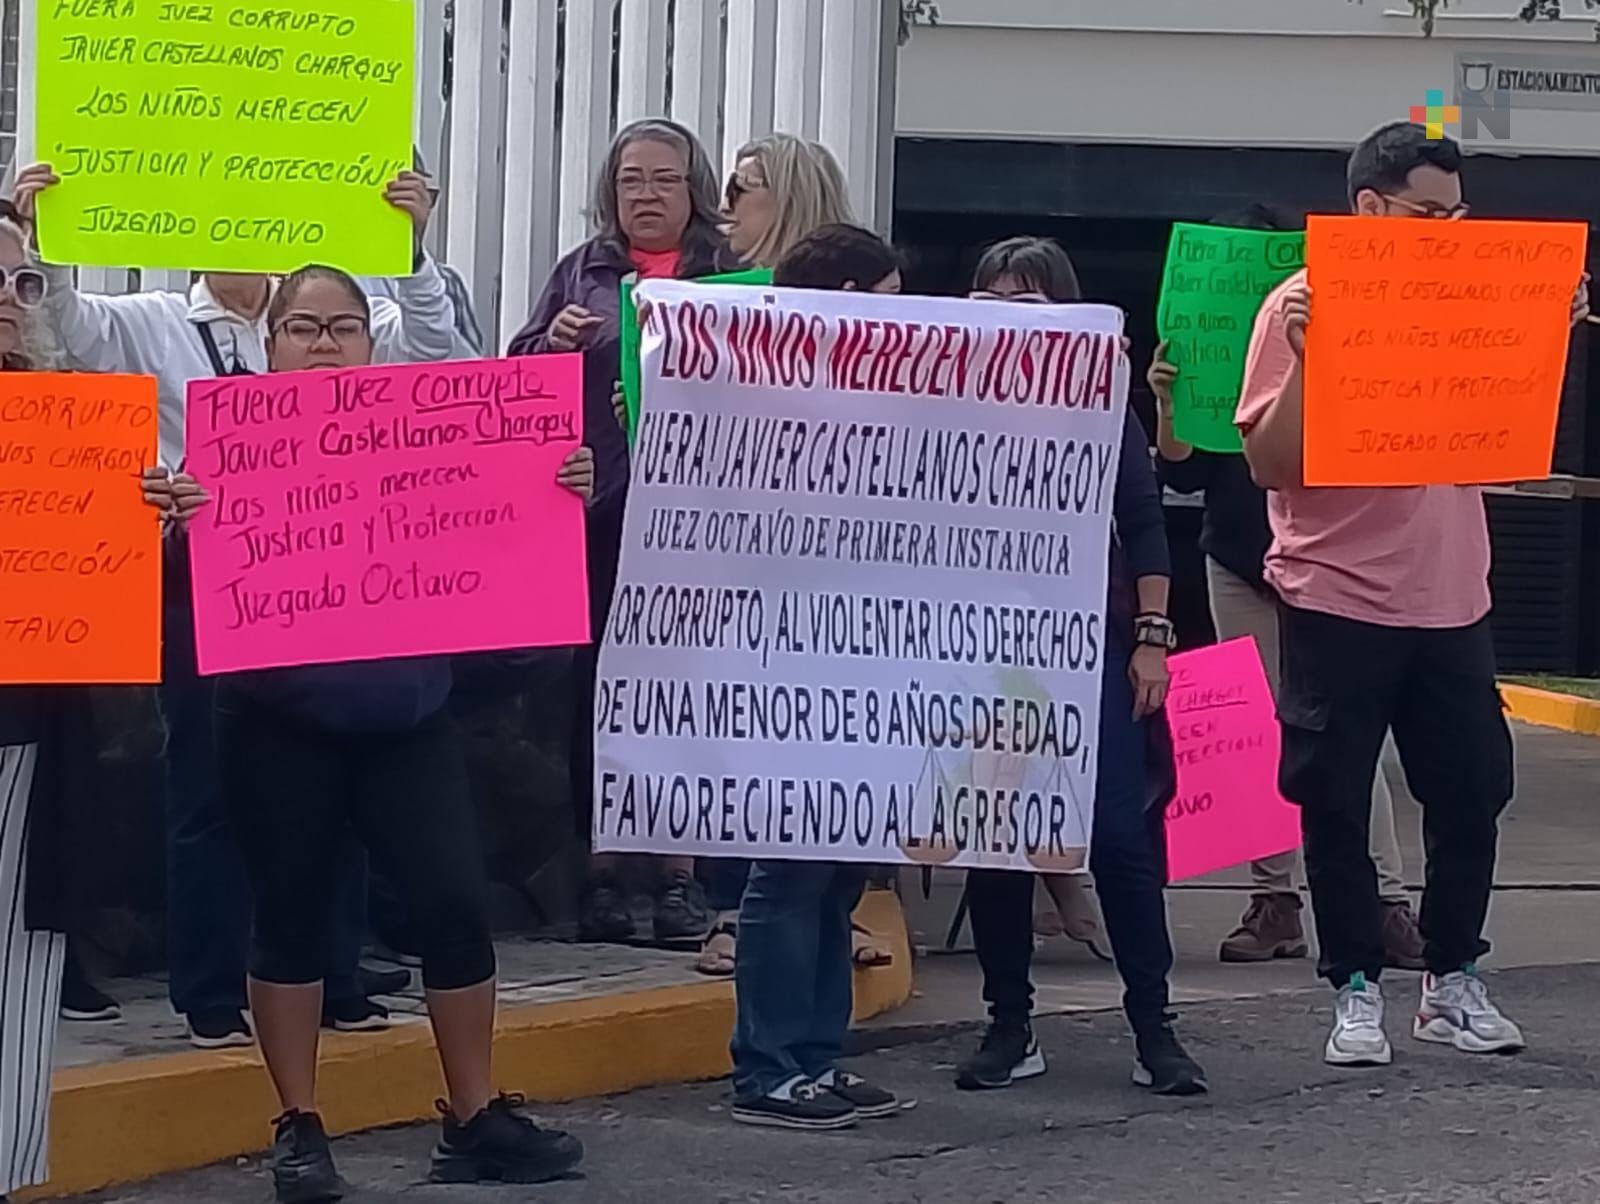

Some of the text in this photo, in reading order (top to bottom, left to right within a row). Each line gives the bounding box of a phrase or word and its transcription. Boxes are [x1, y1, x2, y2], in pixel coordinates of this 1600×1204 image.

[53, 0, 355, 36] FUERA JUEZ CORRUPTO
[59, 35, 402, 83] JAVIER CASTELLANOS CHARGOY
[76, 86, 368, 123] LOS NIÑOS MERECEN
[199, 151, 213, 178] Y
[78, 205, 324, 244] JUZGADO OCTAVO
[727, 294, 826, 388] NIÑOS
[826, 318, 981, 398] MERECEN
[1, 394, 153, 430] CORRUPTO
[198, 383, 302, 431] Fuera
[324, 371, 394, 414] Juez
[1430, 375, 1443, 399] Y
[50, 446, 149, 478] CHARGOY
[202, 405, 576, 478] Javier Castellanos Chargoy
[634, 411, 1112, 514] FUERA! JAVIER CASTELLANOS CHARGOY
[213, 485, 265, 529] Los
[380, 463, 480, 498] merecen
[229, 520, 343, 570] Justicia
[644, 507, 1070, 576] JUEZ OCTAVO DE PRIMERA INSTANCIA
[215, 572, 346, 630] Juzgado
[606, 584, 1100, 672] OR CORRUPTO, AL VIOLENTAR LOS DERECHOS
[4, 616, 90, 644] TAVO
[598, 678, 1090, 775] DE UNA MENOR DE 8 AÑOS DE EDAD,
[599, 772, 1066, 857] FAVORECIENDO AL AGRESOR
